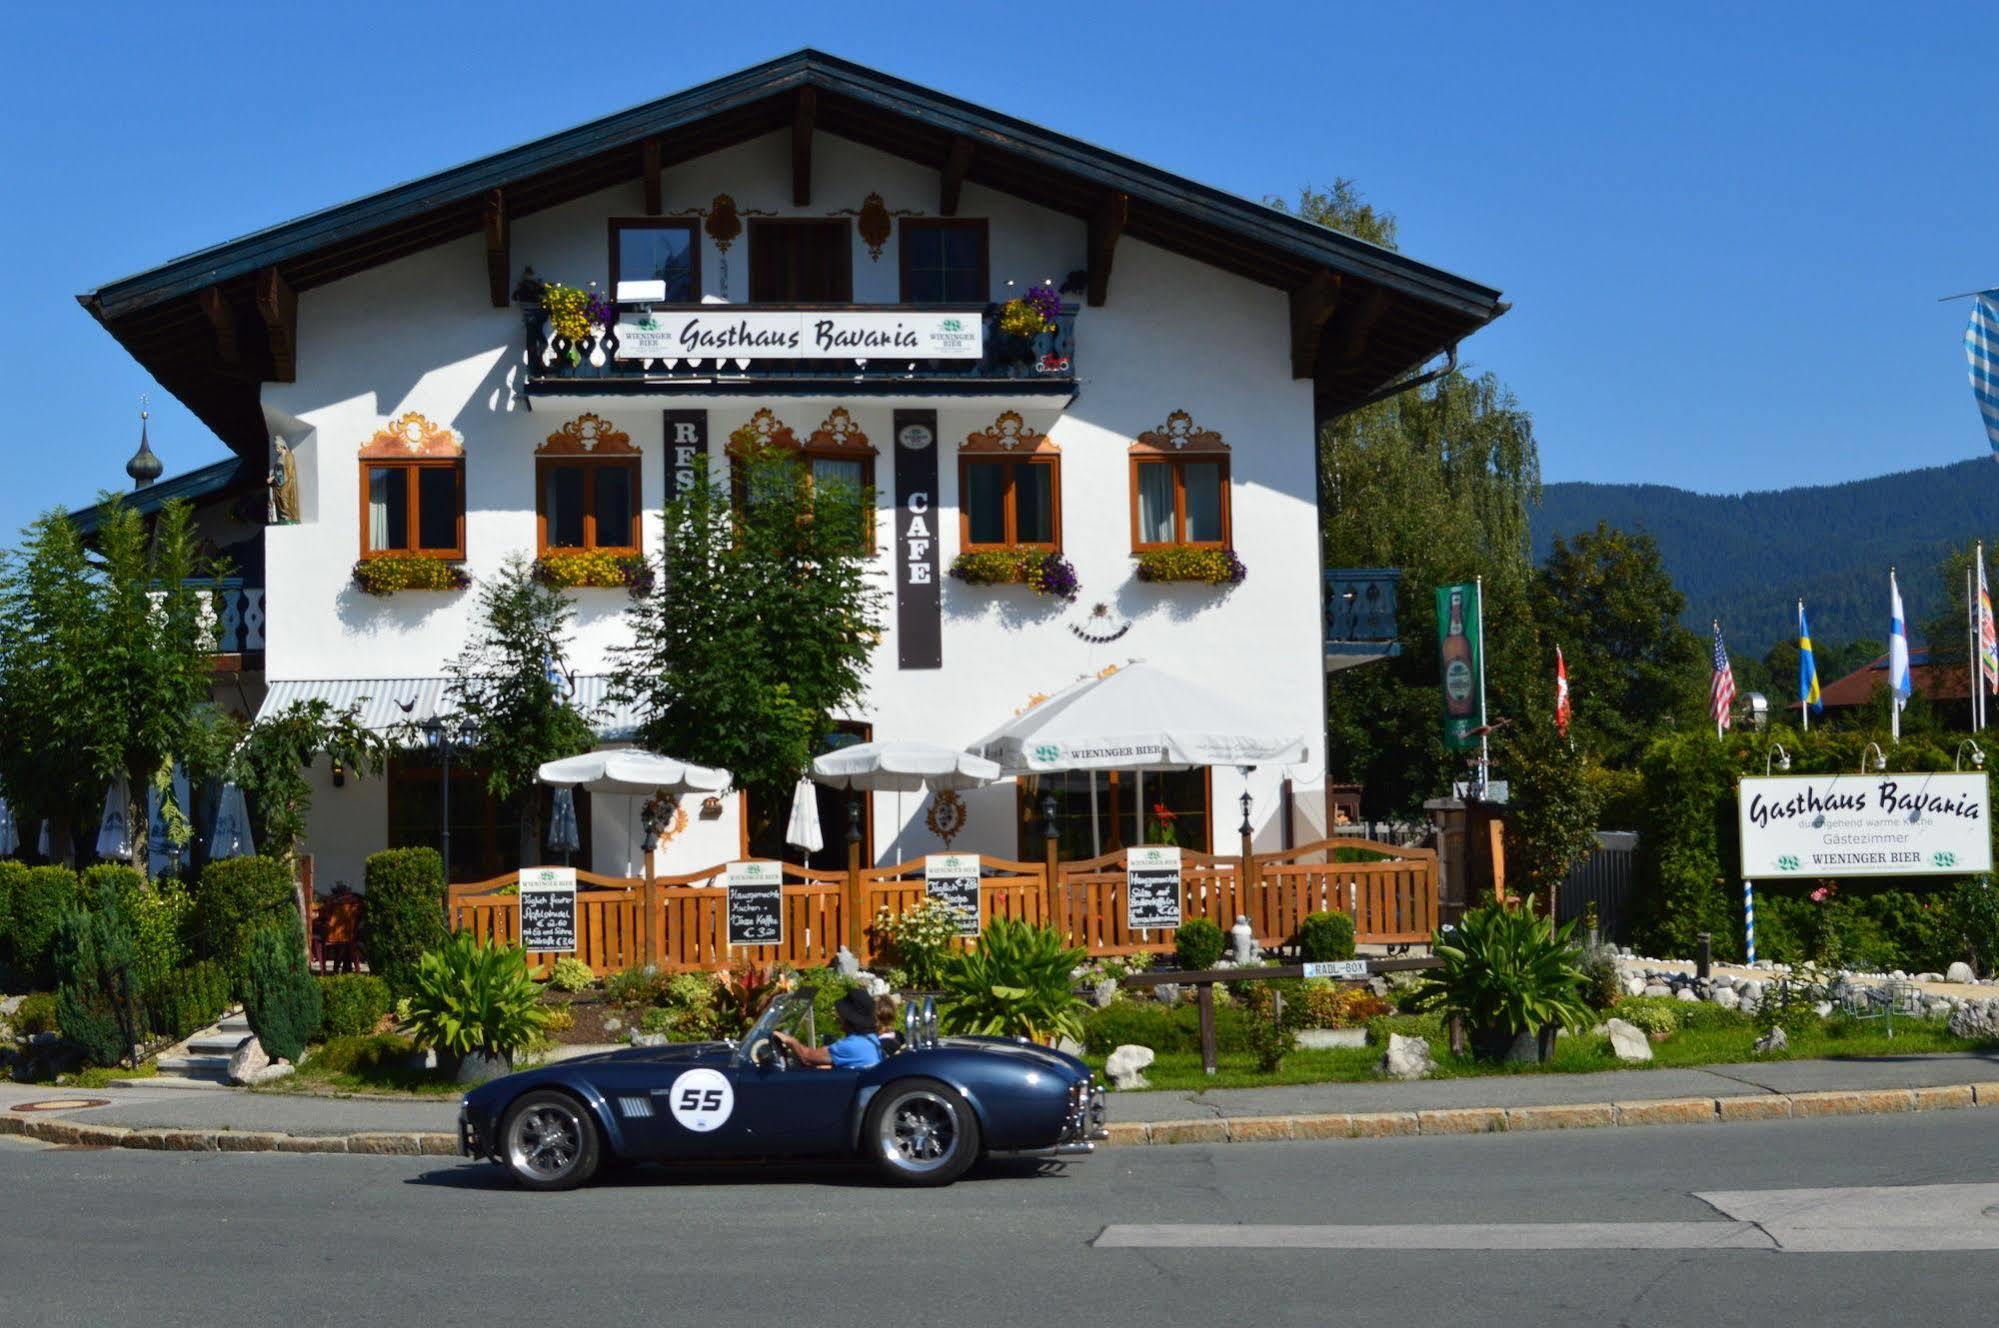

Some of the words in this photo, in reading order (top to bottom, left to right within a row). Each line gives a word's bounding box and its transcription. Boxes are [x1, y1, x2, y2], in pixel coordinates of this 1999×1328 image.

[679, 318, 799, 352] Gasthaus
[814, 319, 918, 352] Bavaria
[906, 492, 931, 584] CAFE
[1072, 747, 1133, 760] WIENINGER
[1136, 745, 1161, 756] BIER
[1750, 785, 1866, 828] Gasthaus
[1879, 781, 1979, 820] Bavaria
[1866, 818, 1899, 827] warme
[1823, 832, 1909, 845] Gästezimmer
[1812, 853, 1887, 865] WIENINGER
[1891, 851, 1921, 863] BIER
[536, 919, 545, 928] €
[1315, 962, 1364, 974] RADL-BOX
[680, 1089, 723, 1111] 55
